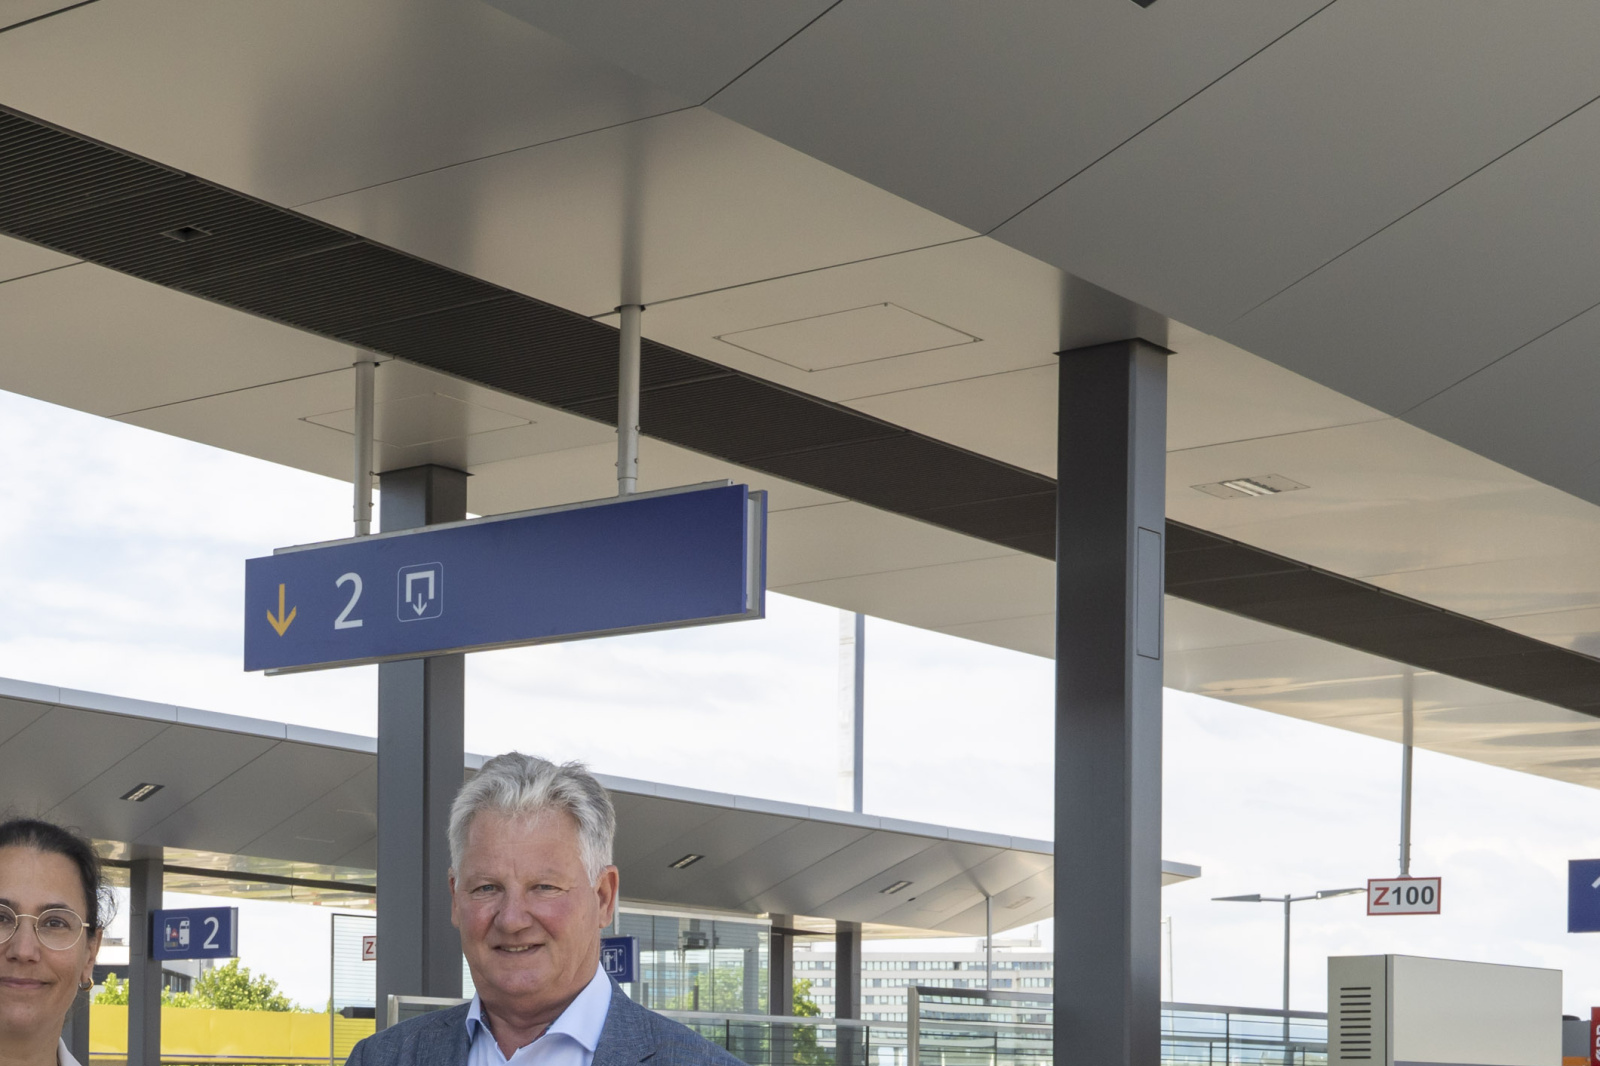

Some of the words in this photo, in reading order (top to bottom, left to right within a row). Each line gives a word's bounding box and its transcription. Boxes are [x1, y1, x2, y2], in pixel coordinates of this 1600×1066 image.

[334, 572, 363, 630] 2
[1373, 886, 1434, 906] Z100
[203, 916, 219, 949] 2
